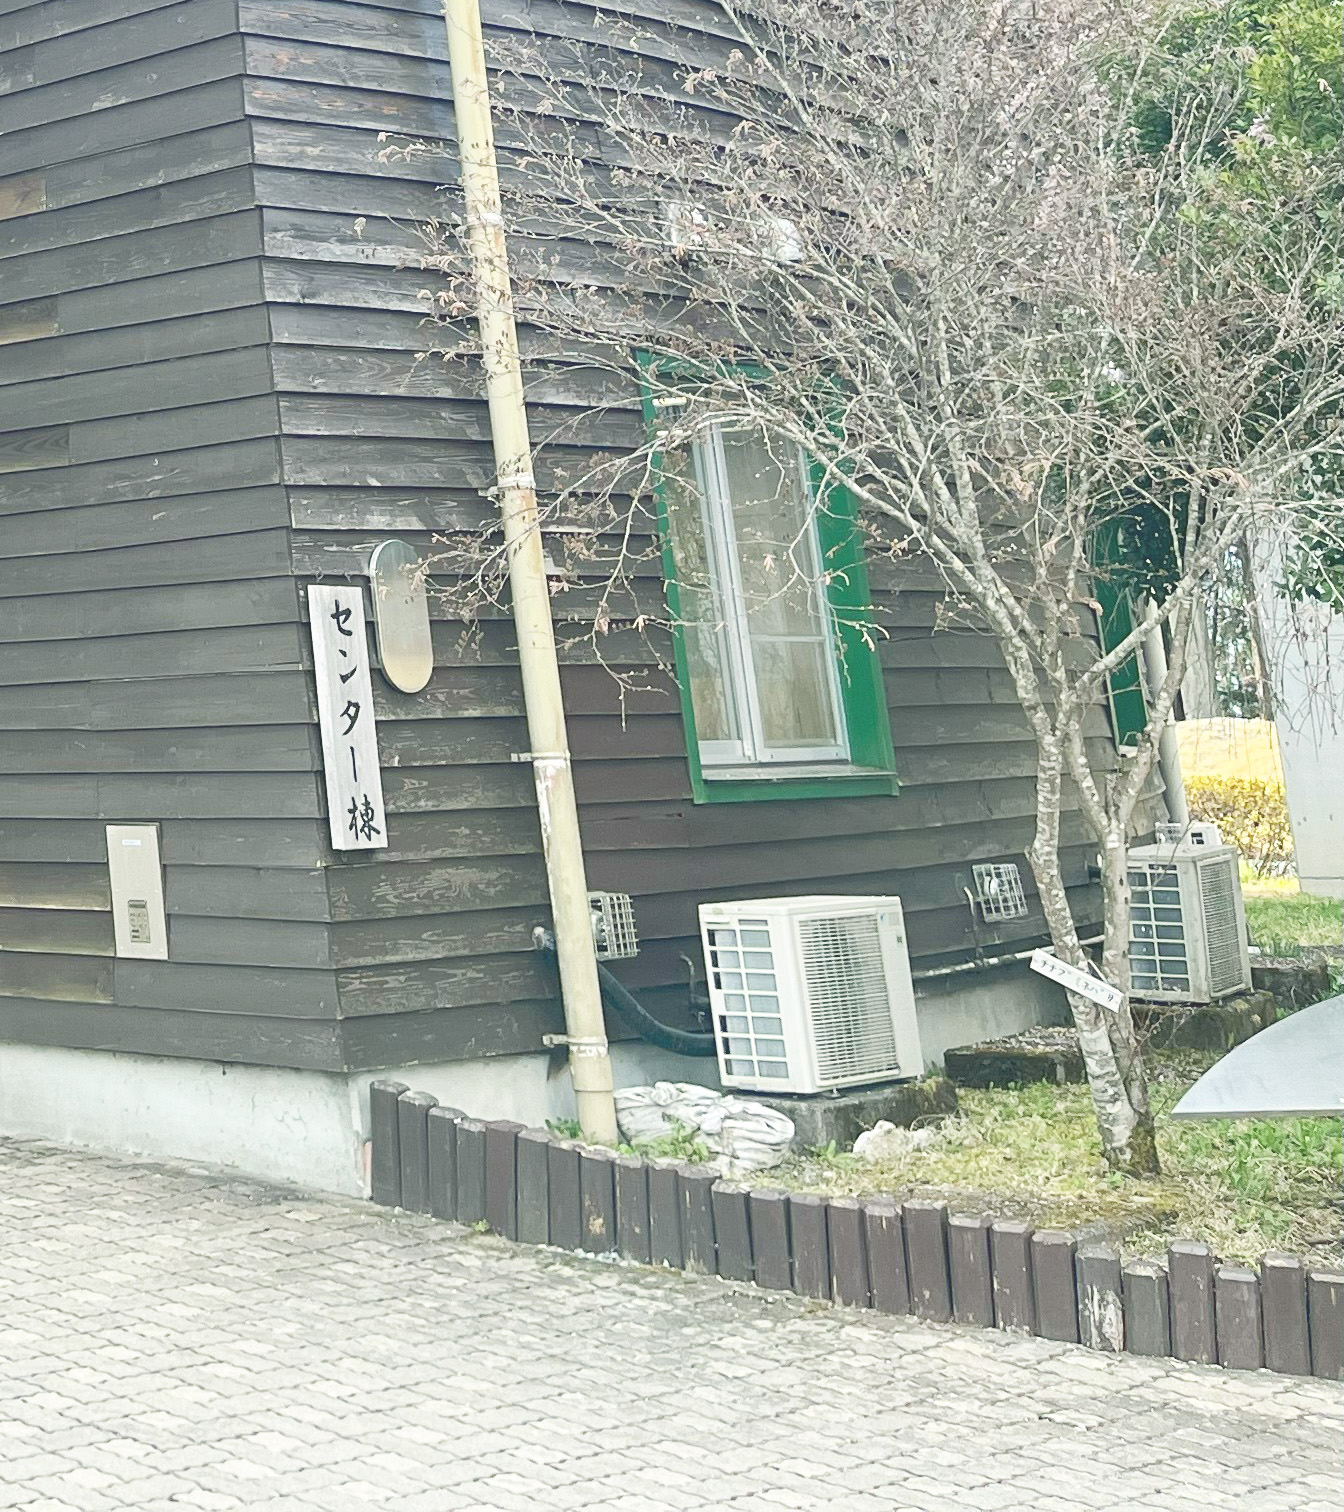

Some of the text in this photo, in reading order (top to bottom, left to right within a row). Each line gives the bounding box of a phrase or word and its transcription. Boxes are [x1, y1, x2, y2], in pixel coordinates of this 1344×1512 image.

[330, 598, 381, 842] センター棟
